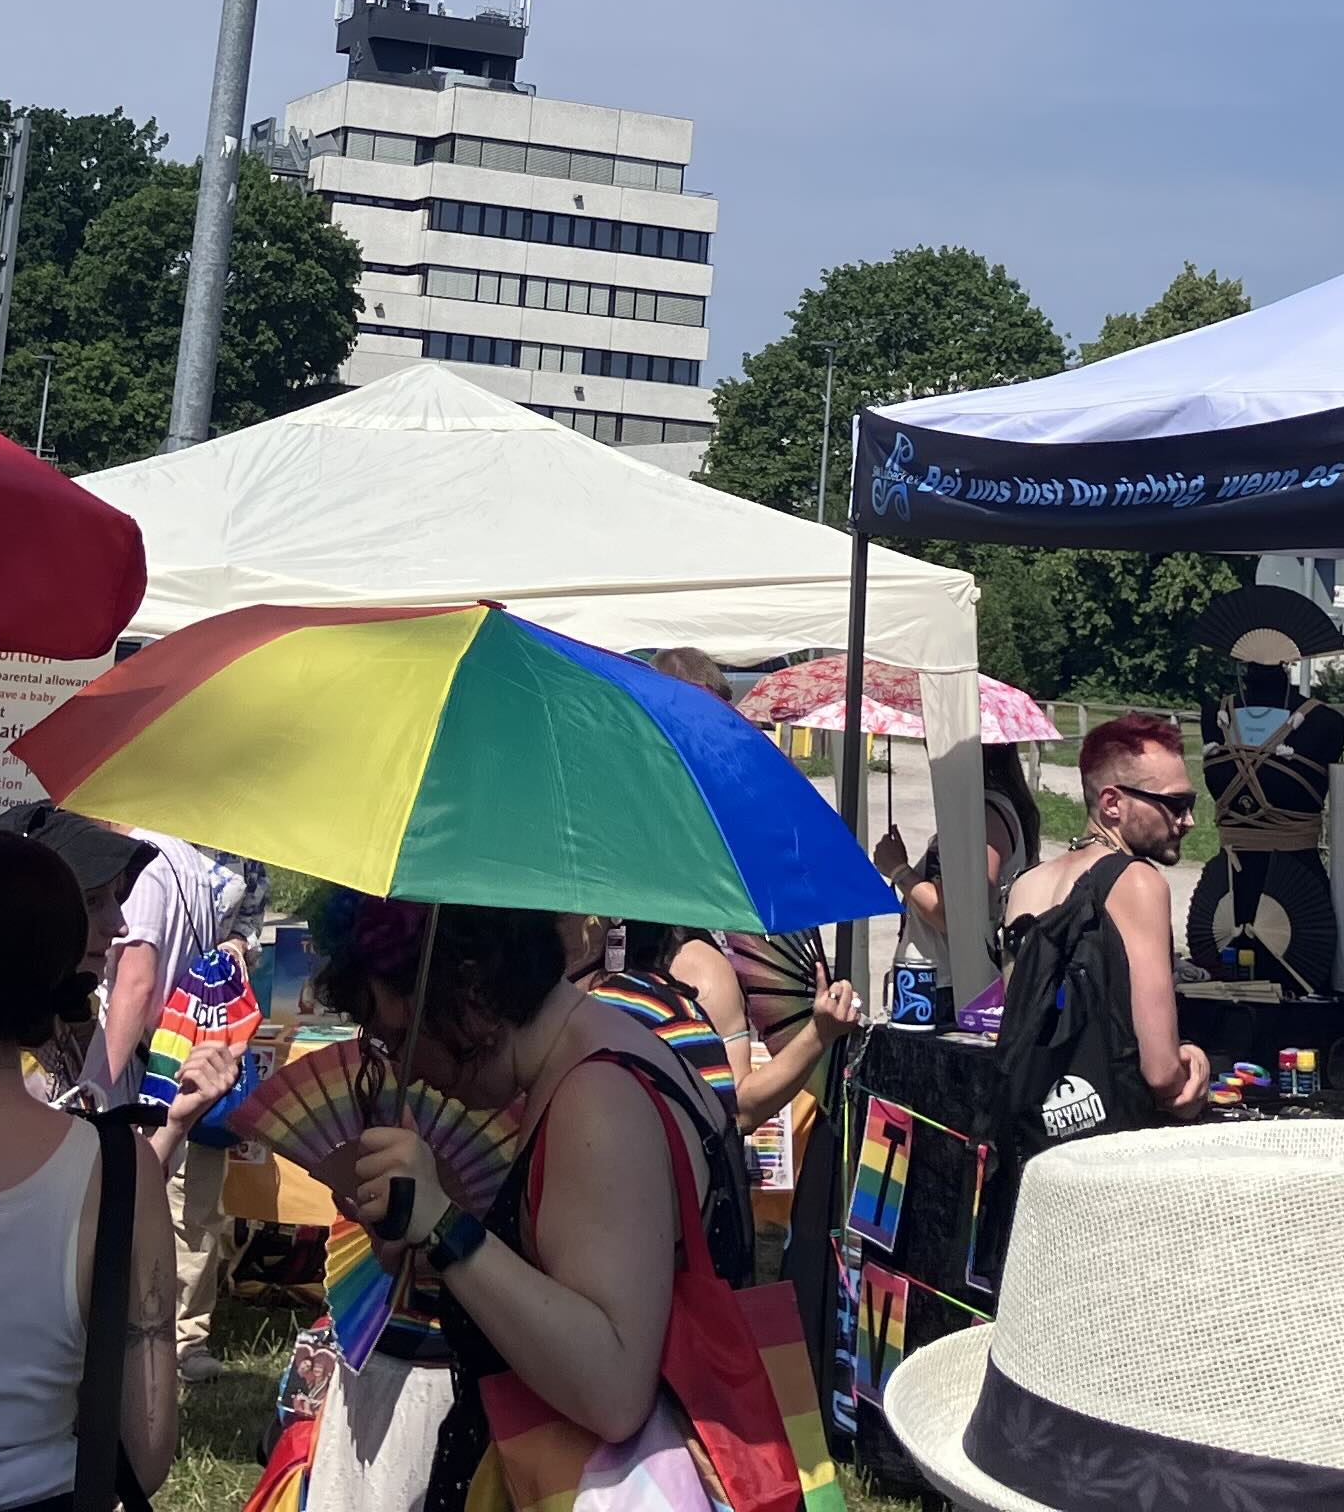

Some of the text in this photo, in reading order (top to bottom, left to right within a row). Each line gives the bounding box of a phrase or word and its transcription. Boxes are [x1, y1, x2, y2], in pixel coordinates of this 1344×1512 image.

[917, 465, 963, 496] Bei
[968, 476, 1011, 504] uns
[1014, 477, 1062, 506] bist
[1069, 478, 1108, 507] Du
[1111, 472, 1206, 508] richtig,
[1216, 469, 1300, 500] wenn
[19, 692, 27, 701] a
[30, 691, 56, 705] baby
